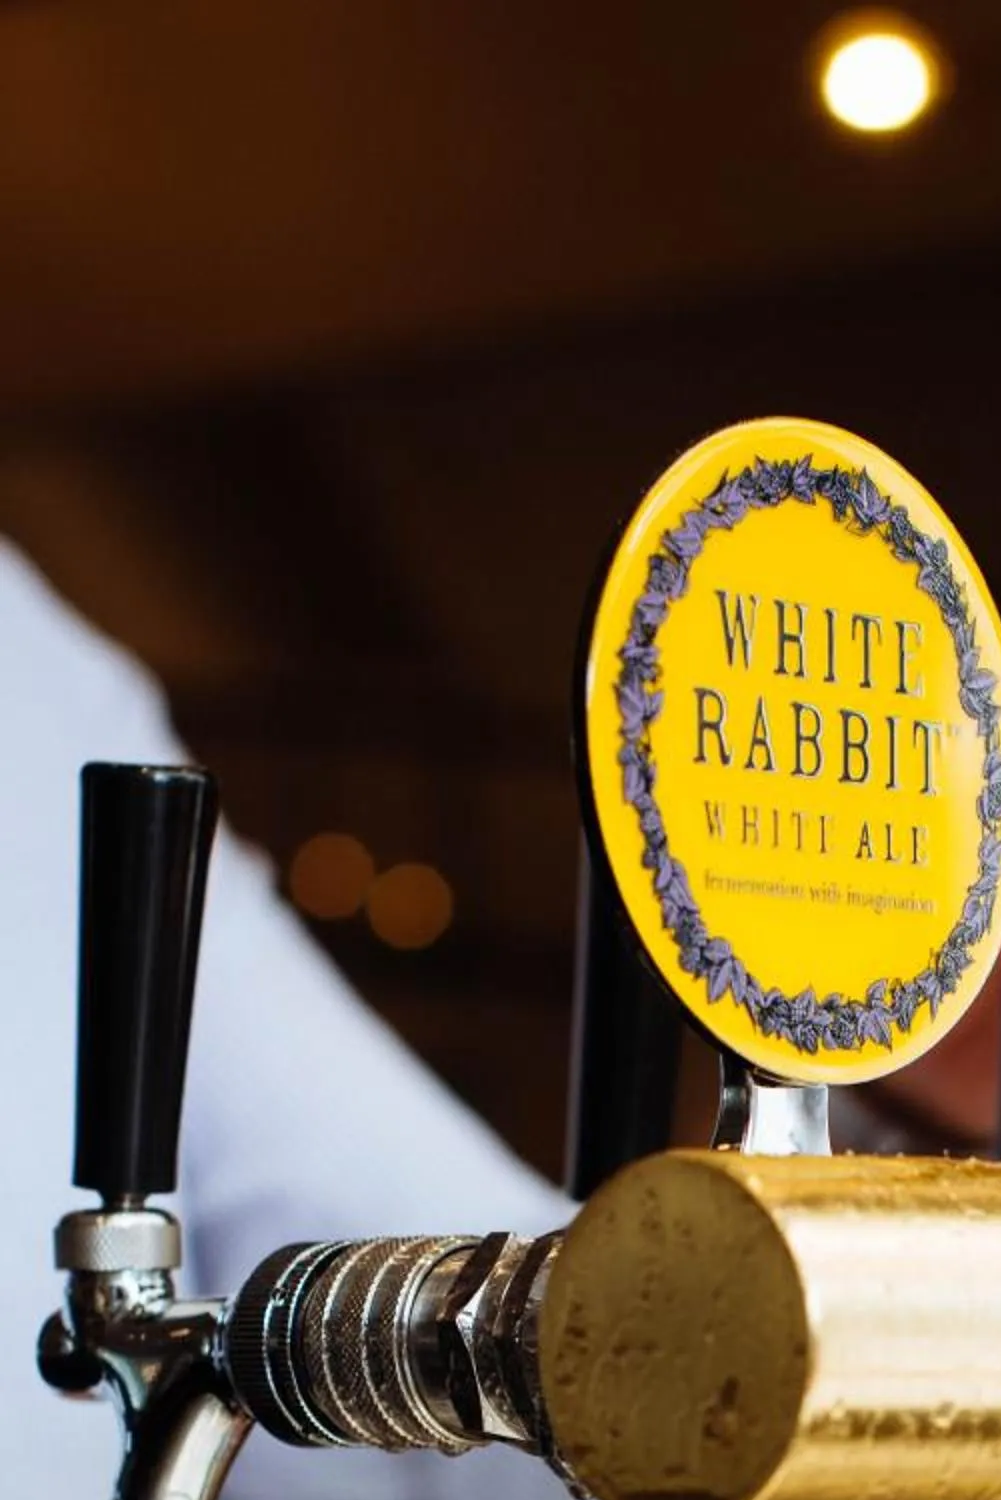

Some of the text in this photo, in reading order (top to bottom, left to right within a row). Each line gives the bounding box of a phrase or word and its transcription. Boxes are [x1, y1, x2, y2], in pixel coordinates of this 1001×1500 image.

[714, 589, 925, 698] WHITE
[693, 686, 944, 796] RABBIT
[854, 820, 931, 867] ALE
